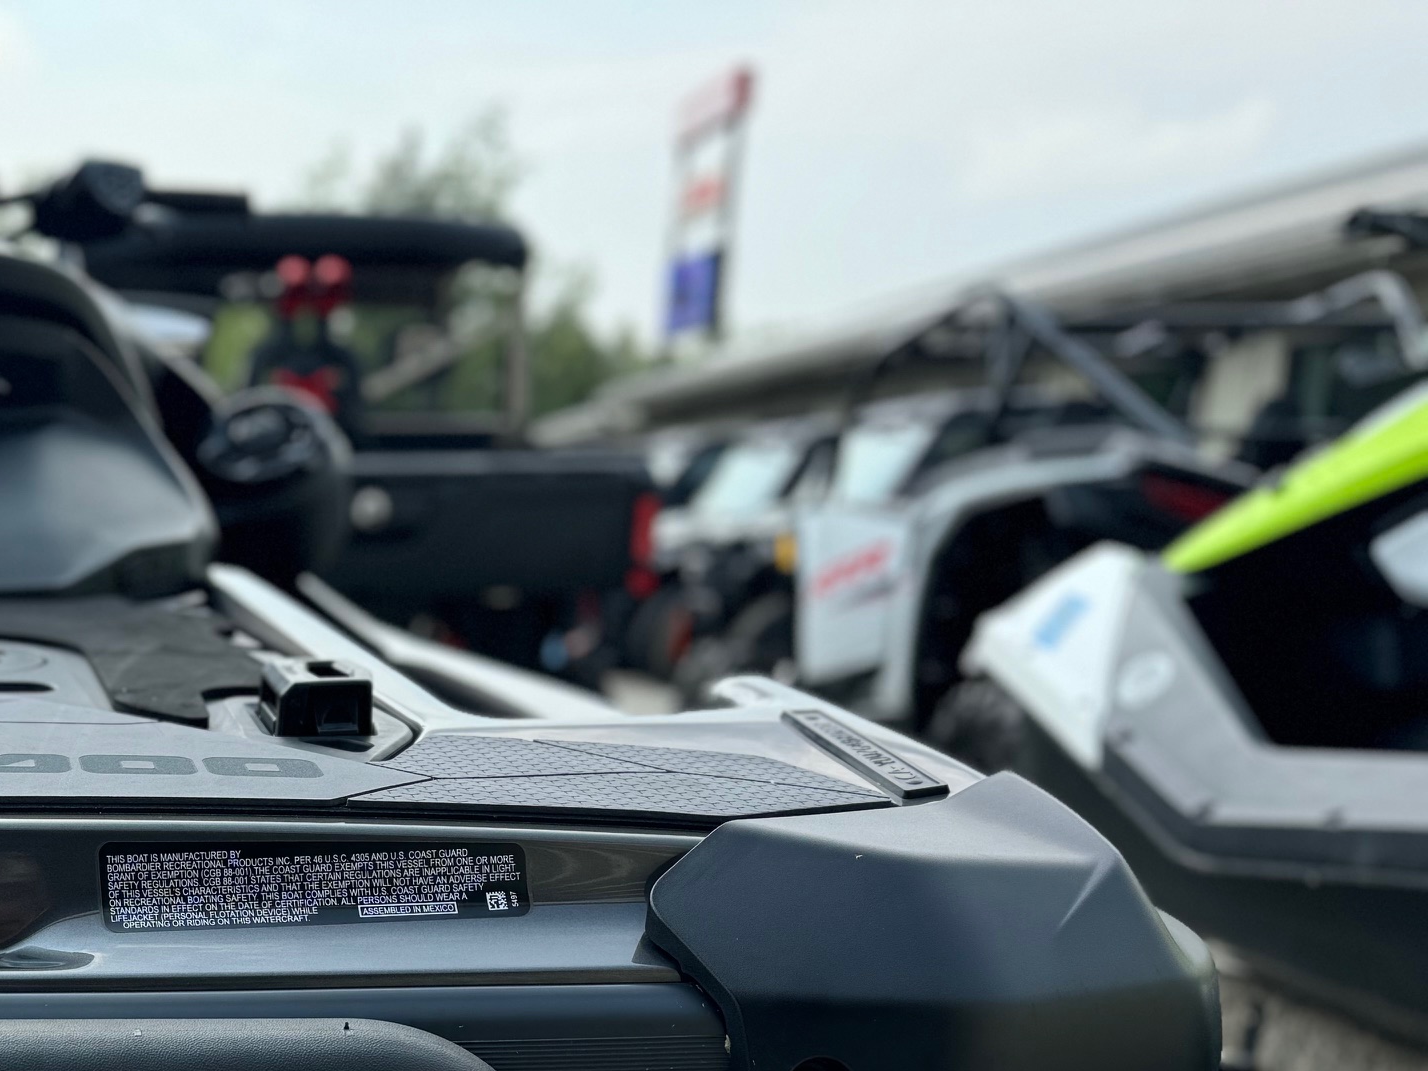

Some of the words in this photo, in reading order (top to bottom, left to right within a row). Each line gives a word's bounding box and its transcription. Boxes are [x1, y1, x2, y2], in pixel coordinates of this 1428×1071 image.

[106, 855, 125, 863] THIS
[127, 854, 148, 862] BOAT
[151, 853, 158, 862] IS
[160, 851, 227, 861] MANUFACTURED
[229, 850, 241, 859] BY
[107, 862, 161, 872] BOMBARDIER
[163, 859, 226, 870] RECREATIONAL
[227, 857, 273, 867] PRODUCTS
[276, 856, 292, 865] INC.
[294, 855, 311, 864] PER
[313, 855, 322, 863] 46
[351, 853, 369, 862] 4305
[372, 852, 389, 861] AND
[391, 851, 406, 860] U.S.
[408, 850, 436, 859] COAST
[439, 849, 468, 858] GUARD
[107, 872, 135, 881] GRANT
[137, 871, 148, 880] OF
[152, 869, 199, 879] EXEMPTION
[201, 868, 221, 877] (CGB
[255, 866, 270, 875] THE
[272, 864, 300, 874] COAST
[303, 863, 332, 873] GUARD
[334, 861, 373, 871] EXEMPTS
[376, 860, 394, 869] THIS
[396, 859, 428, 868] VESSEL
[430, 858, 454, 867] FROM
[456, 857, 474, 866] ONE
[476, 856, 488, 865] OR
[490, 855, 514, 864] MORE
[108, 880, 139, 890] SAFETY
[203, 877, 221, 886] CGB
[223, 876, 248, 885] 88-001
[251, 874, 282, 884] STATES
[284, 873, 303, 882] THAT
[306, 872, 341, 881] CERTAIN
[344, 869, 401, 880] REGULATIONS
[403, 868, 420, 877] ARE
[422, 866, 479, 876] INAPPLICABLE
[482, 865, 490, 874] IN
[492, 864, 515, 873] LIGHT
[111, 913, 158, 922] LIFEJACKET
[161, 911, 208, 921] (PERSONAL
[210, 909, 254, 919] FLOTATION
[257, 908, 291, 917] DEVICE)
[292, 907, 318, 915] WHILE
[363, 906, 411, 915] ASSEMBLED
[413, 905, 421, 913] IN
[423, 904, 454, 913] MEXICO
[123, 920, 170, 929] OPERATING
[172, 919, 185, 927] OR
[187, 918, 215, 926] RIDING
[232, 917, 251, 925] THIS
[252, 915, 310, 924] WATERCRAFT.
